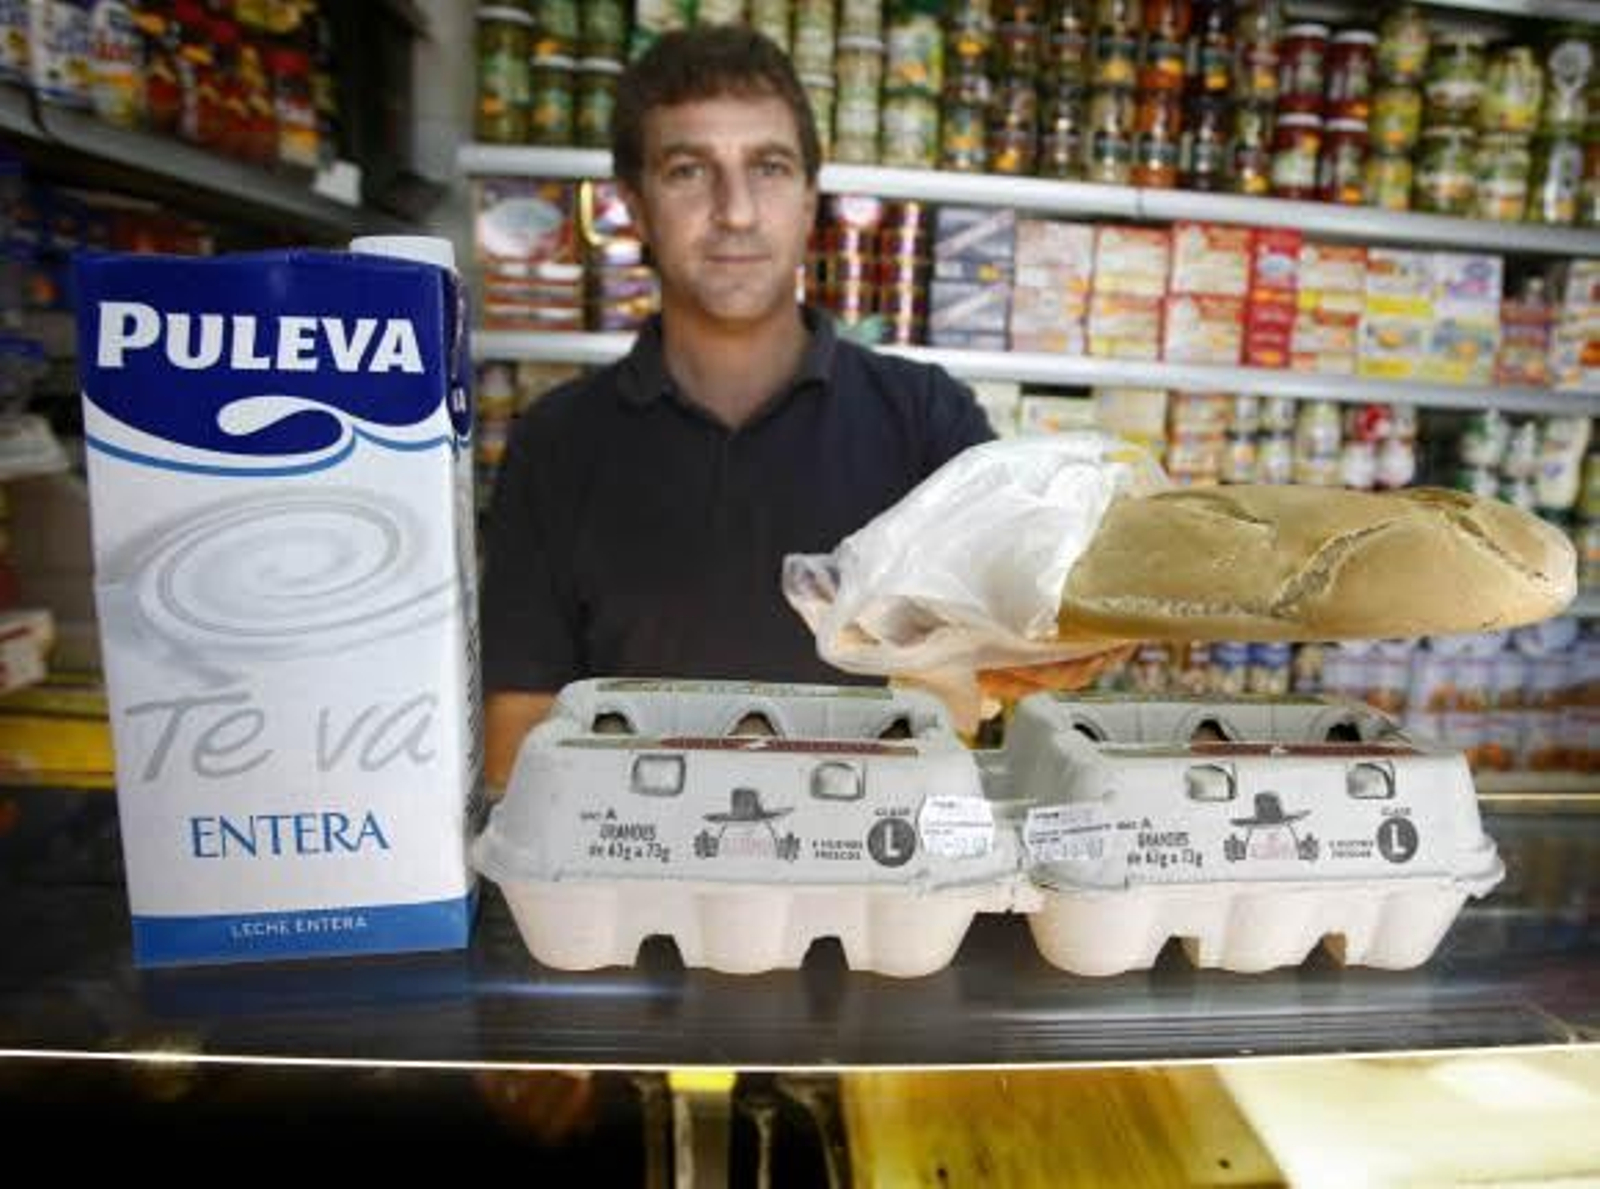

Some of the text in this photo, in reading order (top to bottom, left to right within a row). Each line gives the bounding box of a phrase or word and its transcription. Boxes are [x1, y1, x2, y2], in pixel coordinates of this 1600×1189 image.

[97, 301, 425, 373] PULEVA
[315, 690, 440, 773] va
[189, 810, 390, 858] ENTERA
[884, 823, 901, 858] L
[1390, 823, 1407, 854] L
[232, 916, 367, 938] LECHE ENTERA
